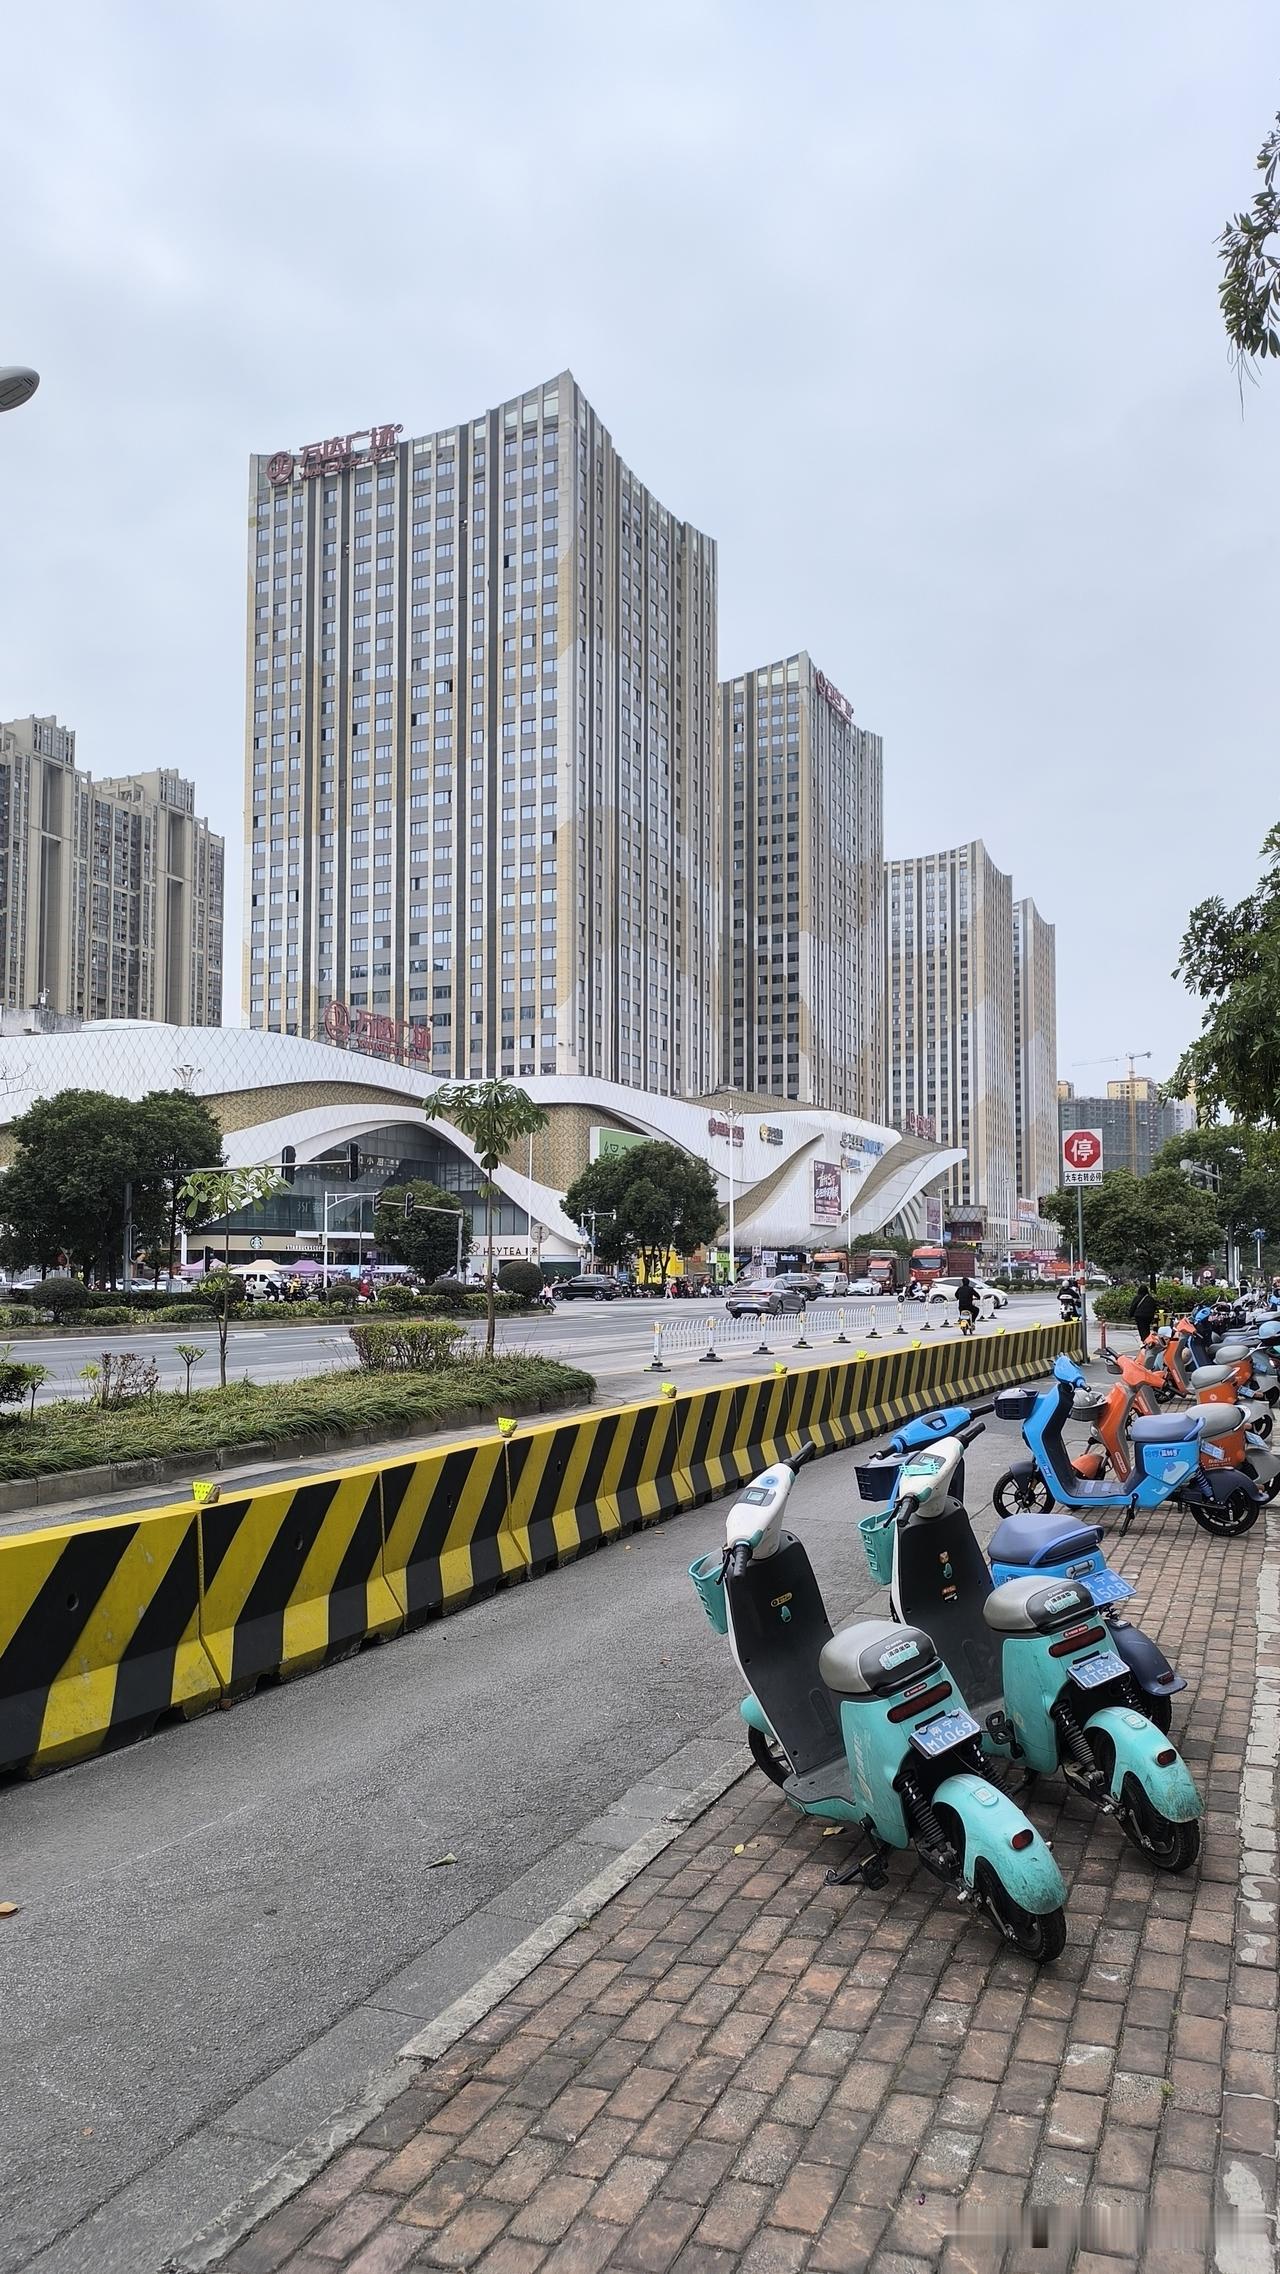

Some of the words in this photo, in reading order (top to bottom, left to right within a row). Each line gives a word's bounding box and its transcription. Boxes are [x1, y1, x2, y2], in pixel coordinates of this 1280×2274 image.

[299, 423, 396, 466] 万达广场
[356, 1009, 432, 1050] 万达广场
[1070, 1139, 1094, 1162] 停
[1065, 1172, 1102, 1182] 大车右转必停
[483, 1246, 522, 1256] HEYTEA
[1082, 1662, 1124, 1684] TT533
[926, 1721, 973, 1752] MY069
